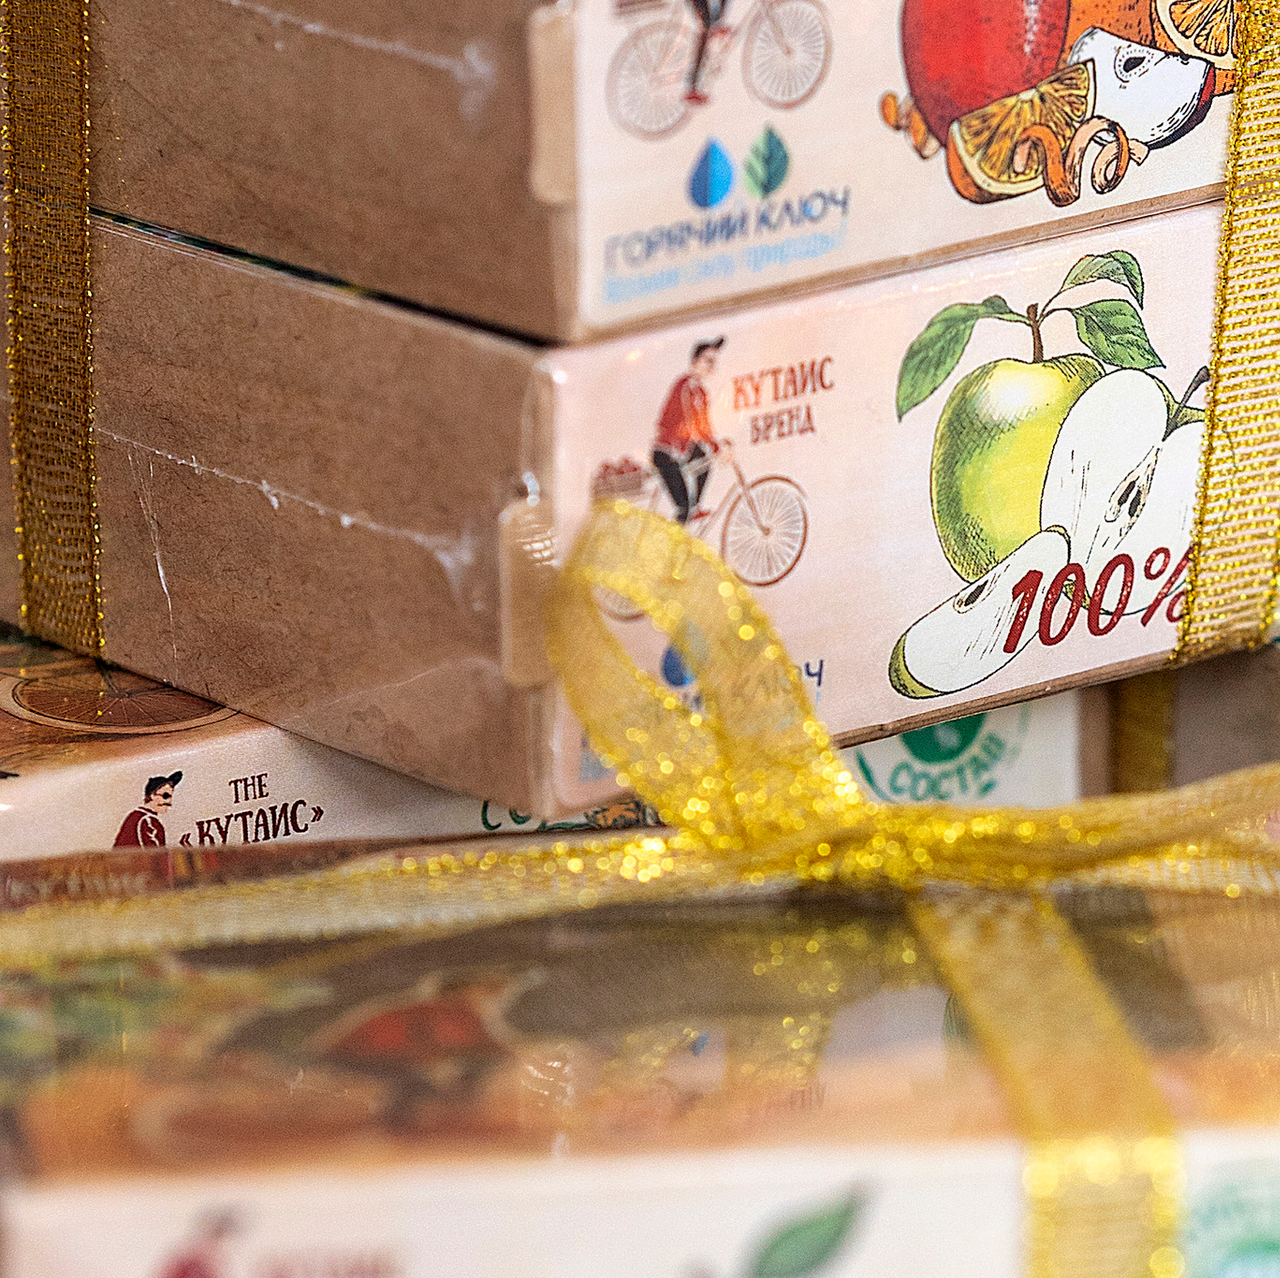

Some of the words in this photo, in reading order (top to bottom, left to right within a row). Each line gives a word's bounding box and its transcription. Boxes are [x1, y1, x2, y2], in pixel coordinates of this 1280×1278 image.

[732, 356, 835, 412] КУТАИС
[749, 403, 817, 446] БРЕНД
[1002, 546, 1194, 654] 100%
[228, 772, 270, 804] THE
[179, 799, 324, 848] «КУТАИС»
